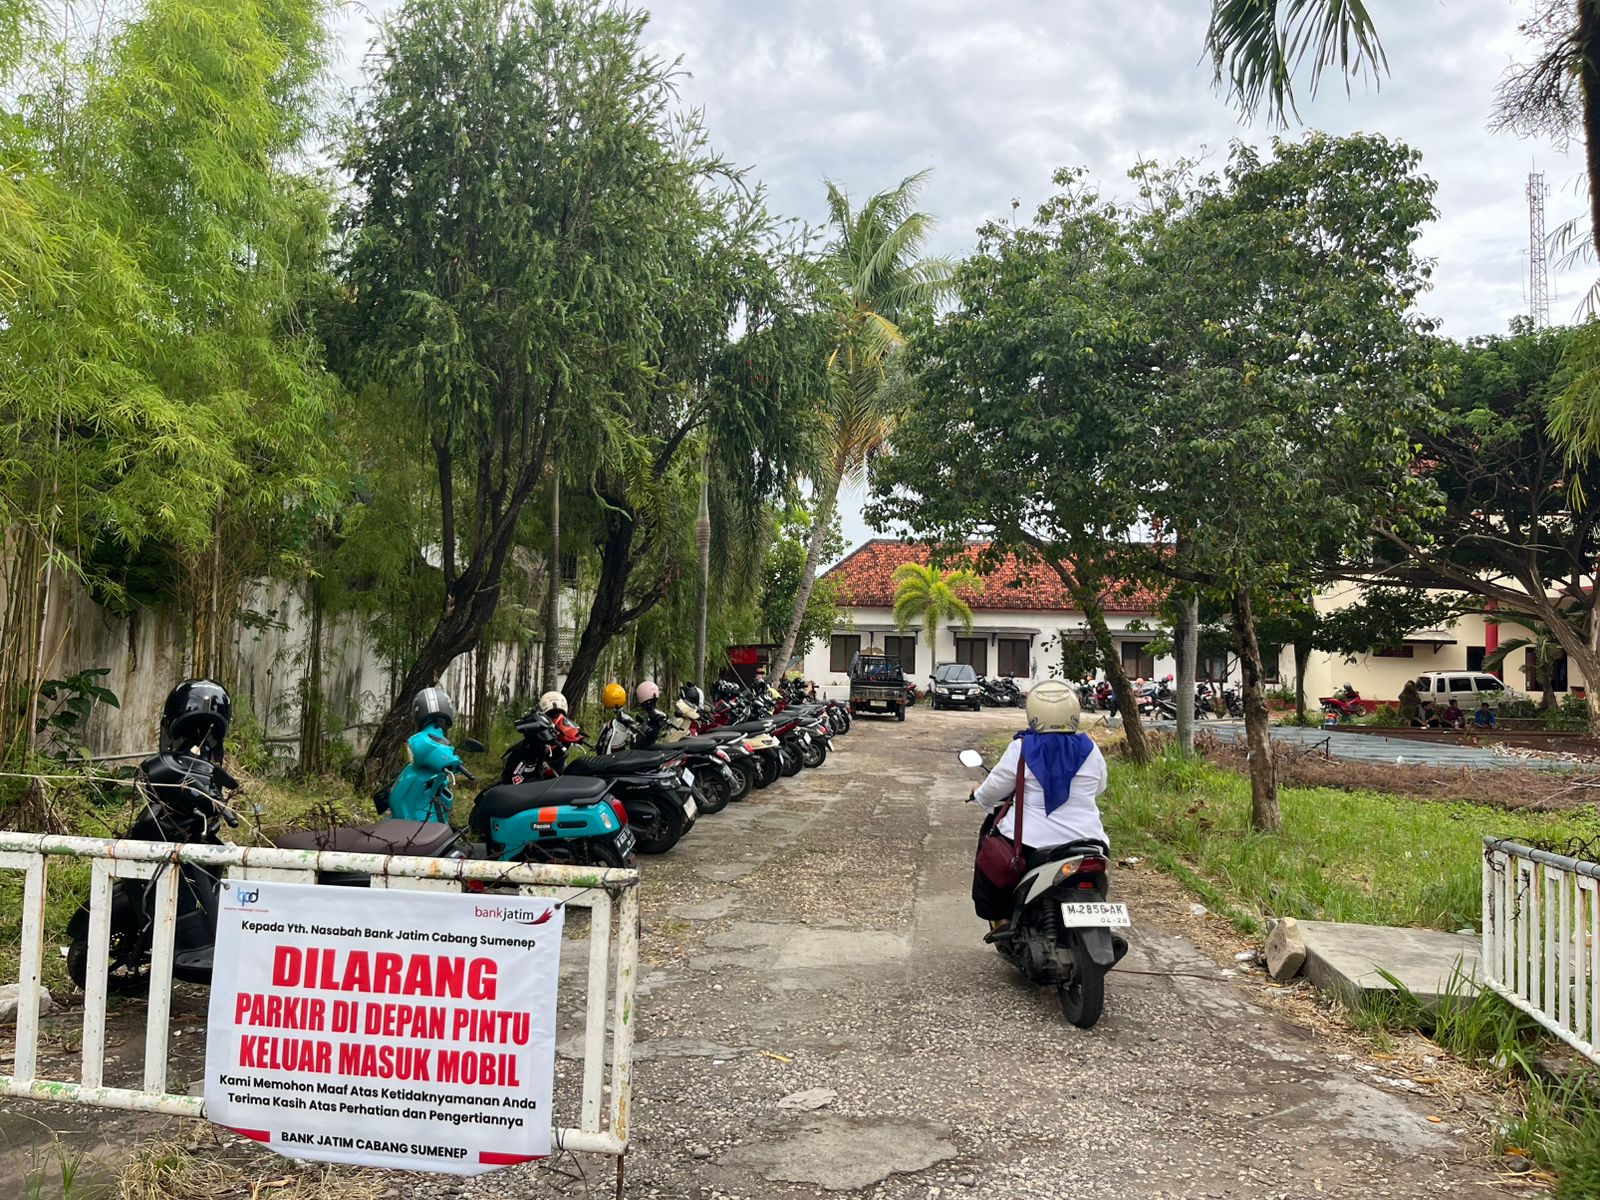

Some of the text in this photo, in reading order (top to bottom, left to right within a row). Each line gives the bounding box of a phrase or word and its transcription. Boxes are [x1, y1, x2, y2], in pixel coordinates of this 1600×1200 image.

[475, 906, 534, 922] bankjatim
[1109, 904, 1123, 914] AK
[241, 920, 535, 950] Kepada Yth. Nasabah Bank Jatim Cabang Sumenep
[272, 946, 498, 1001] DILARANG
[235, 993, 530, 1046] PARKIR DI DEPAN PINTU
[240, 1035, 520, 1087] KELUAR MASUK MOBIL
[220, 1075, 536, 1109] Kami Memohon Maaf Atas Ketidaknyamanan Anda
[228, 1093, 523, 1129] Terima Kasih Atas Perhatian dan Pengertiannya
[282, 1132, 467, 1158] BANK JATIM CABANG SUMENEP
